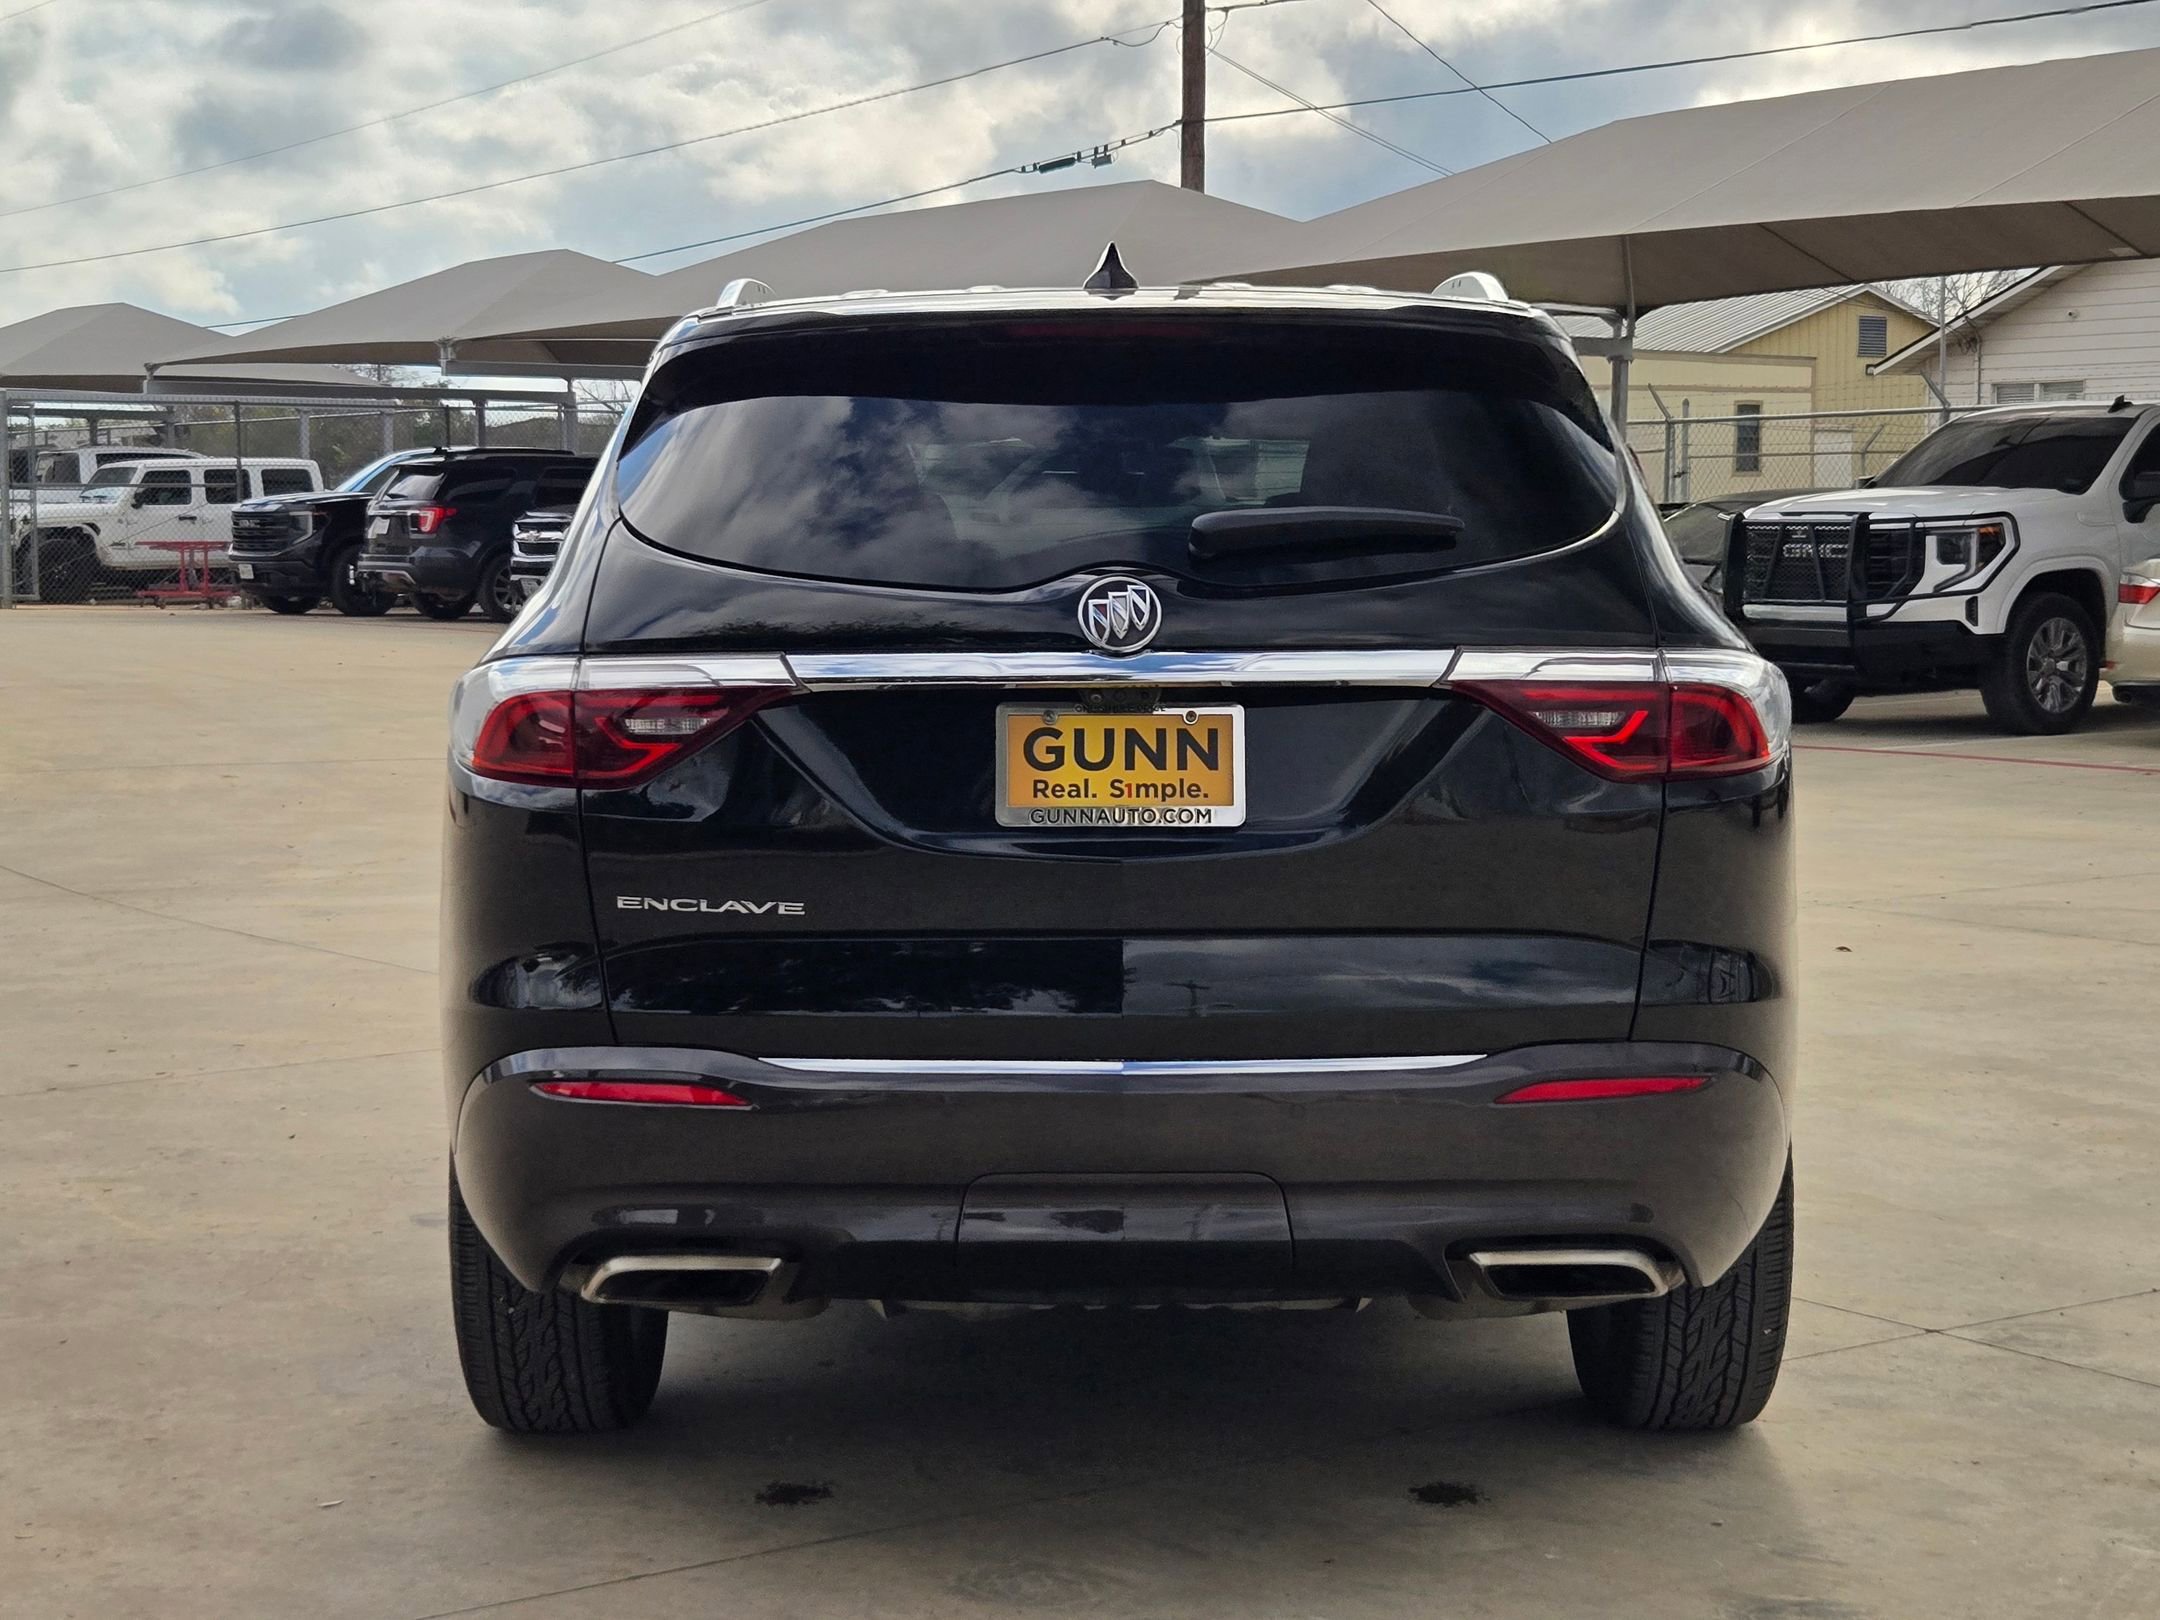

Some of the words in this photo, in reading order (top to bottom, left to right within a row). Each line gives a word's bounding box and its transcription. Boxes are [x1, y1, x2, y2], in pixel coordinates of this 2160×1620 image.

[1023, 727, 1219, 772] GUNN
[1032, 778, 1097, 799] Real.
[1030, 808, 1212, 824] GUNNAUTO.COM
[617, 896, 805, 915] ENCLAVE
